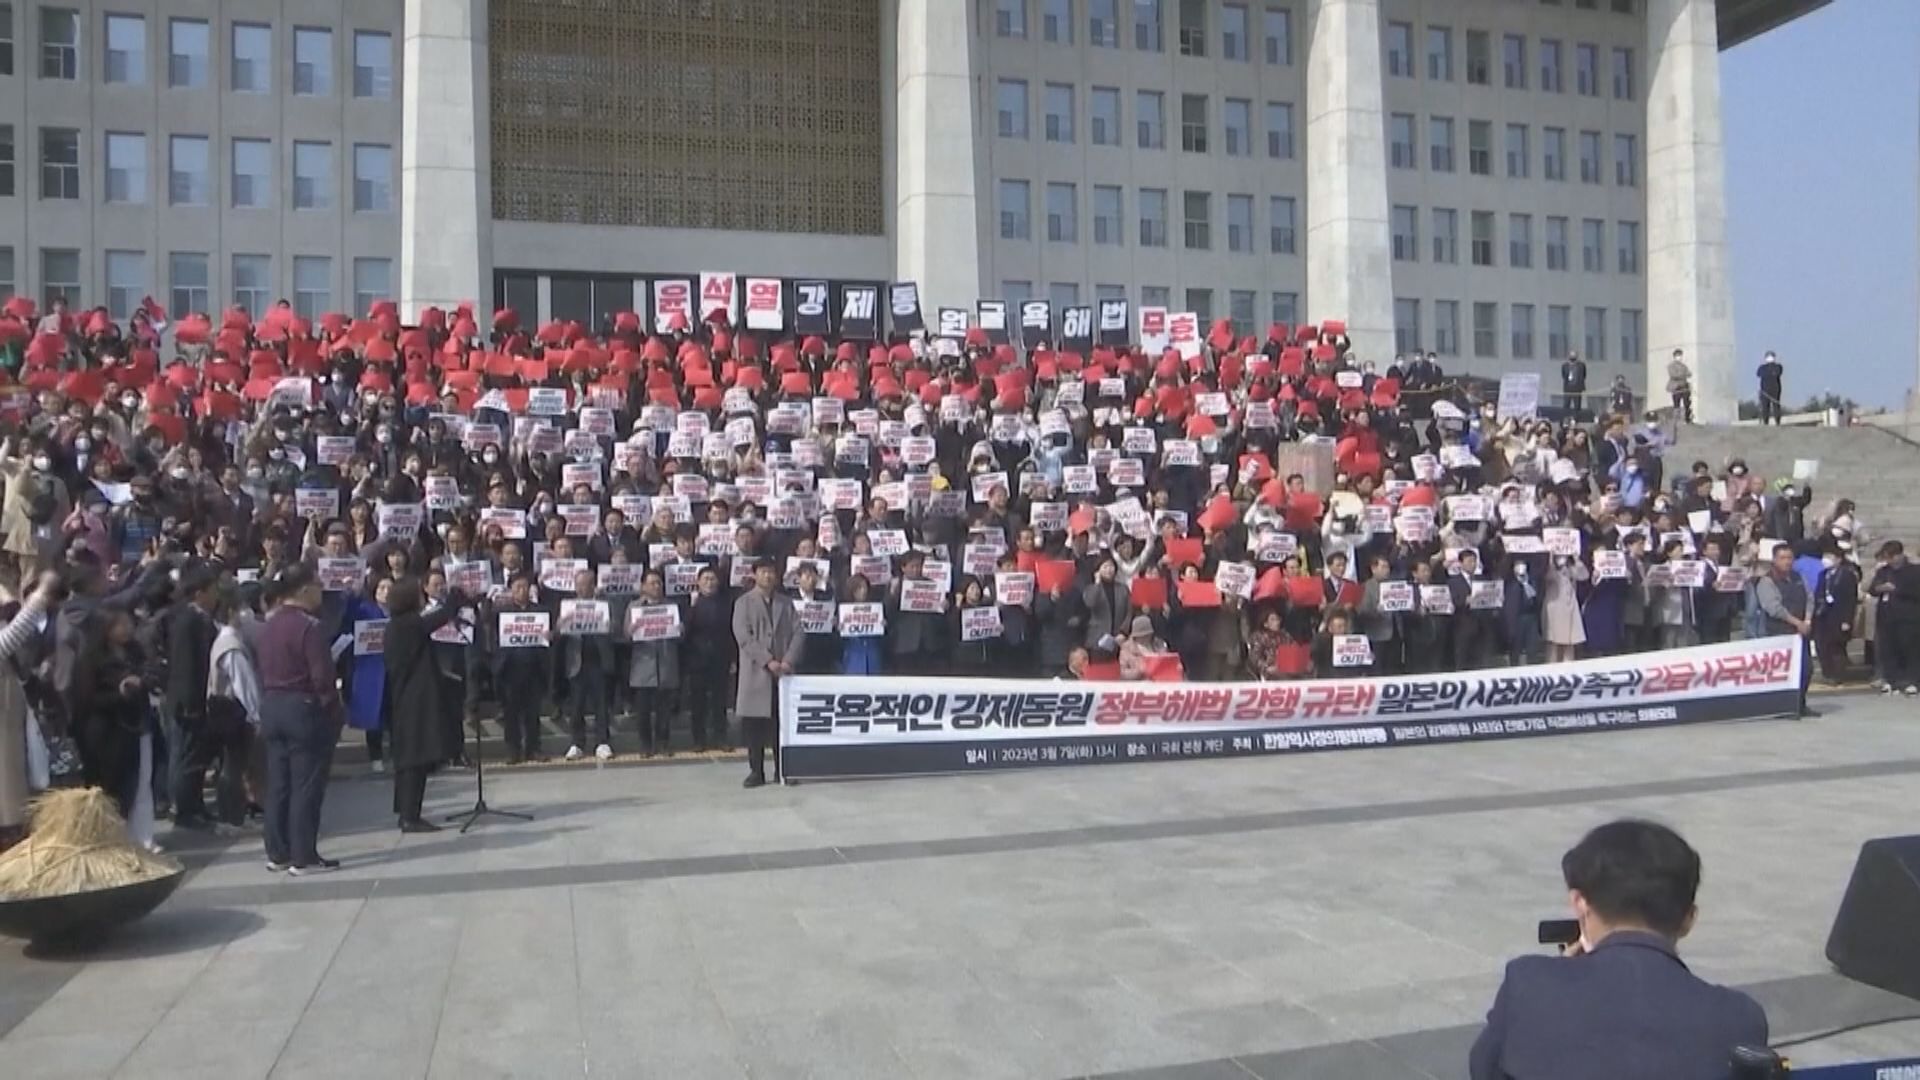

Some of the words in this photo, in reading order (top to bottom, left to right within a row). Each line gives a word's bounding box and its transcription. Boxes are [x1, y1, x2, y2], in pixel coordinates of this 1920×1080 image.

[796, 693, 947, 734] 굴욕적인
[949, 691, 1095, 730] 강제동원
[1094, 688, 1234, 726] 정부해법
[1232, 685, 1302, 721] 강행
[1302, 682, 1377, 717] 규탄!
[1376, 680, 1468, 715] 일본의
[1467, 674, 1583, 708] 사죄배상
[1579, 668, 1642, 698] 촉구!
[1641, 661, 1696, 695] 긴급
[1694, 648, 1793, 688] 시국선언
[965, 748, 987, 763] 일시
[1002, 746, 1038, 761] 2023년
[1041, 745, 1058, 760] 3월
[1127, 742, 1147, 757] 장소
[1161, 741, 1180, 755] 국회
